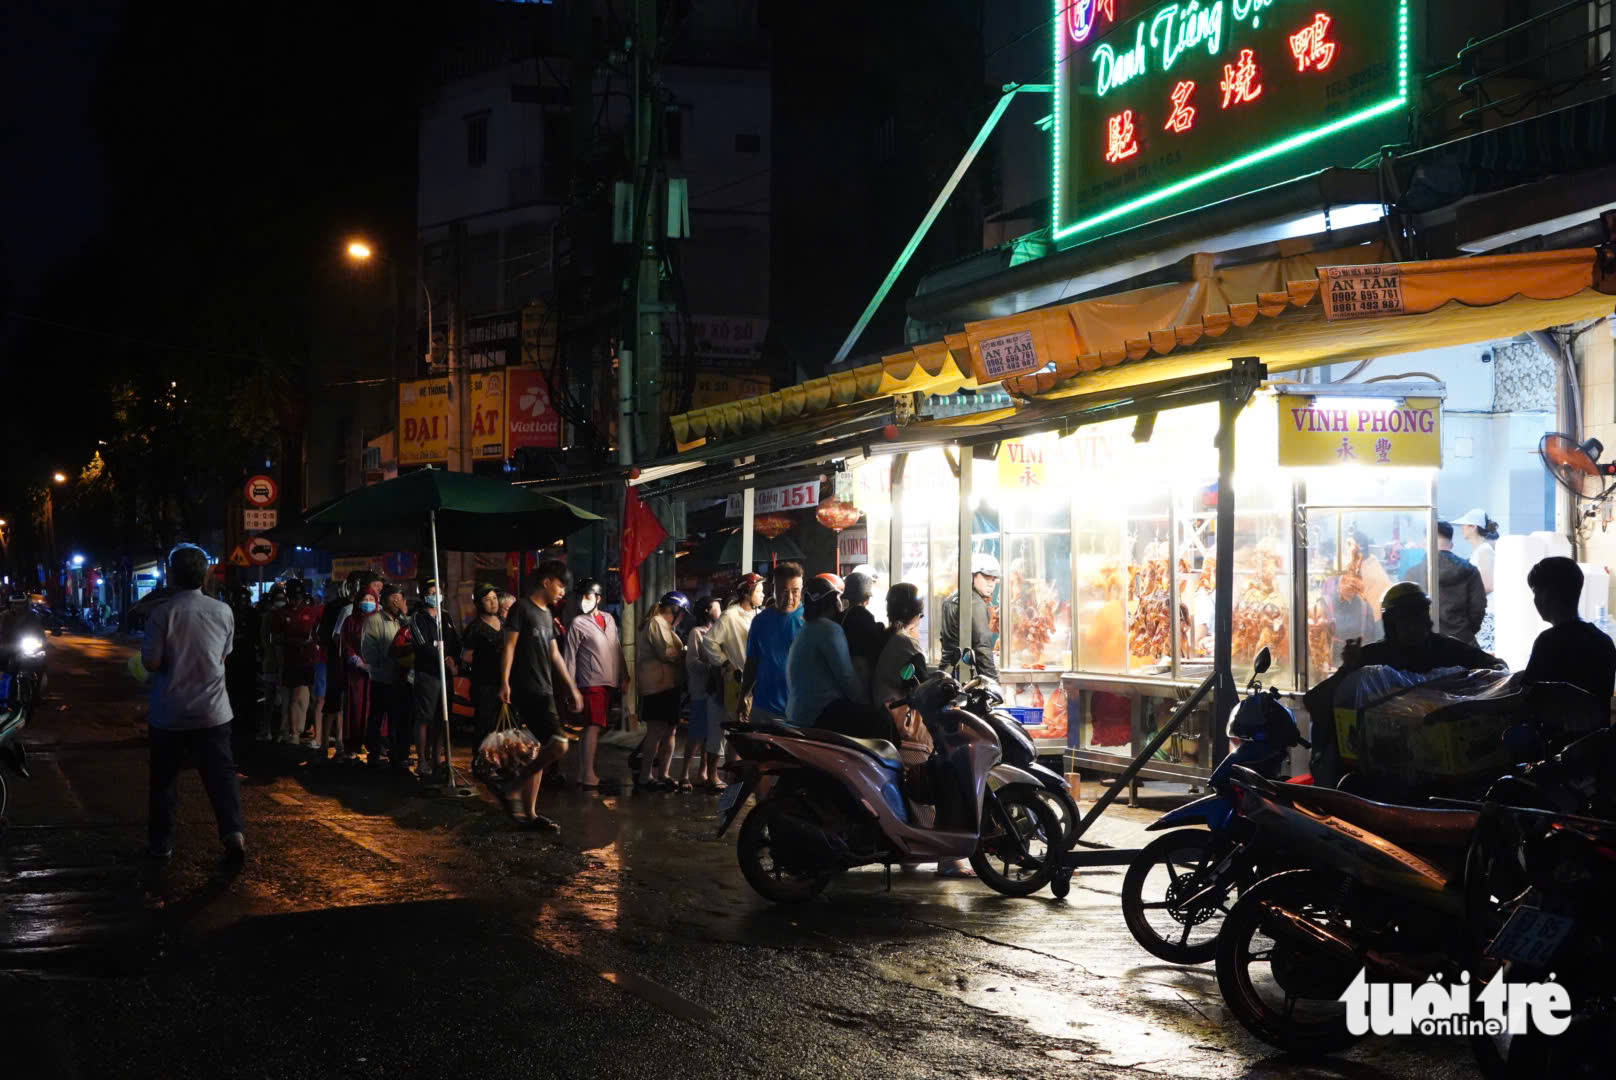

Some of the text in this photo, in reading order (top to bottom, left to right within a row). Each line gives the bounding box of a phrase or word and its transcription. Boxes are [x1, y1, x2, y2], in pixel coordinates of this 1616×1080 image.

[1091, 21, 1146, 97] Danh
[1332, 279, 1354, 291] AN
[1332, 289, 1398, 303] 0902 695 761
[985, 342, 1032, 360] AN TÂM
[511, 421, 558, 433] Vietlott
[1356, 409, 1435, 433] PHONG
[404, 416, 439, 447] ĐẠI
[781, 485, 816, 508] 151
